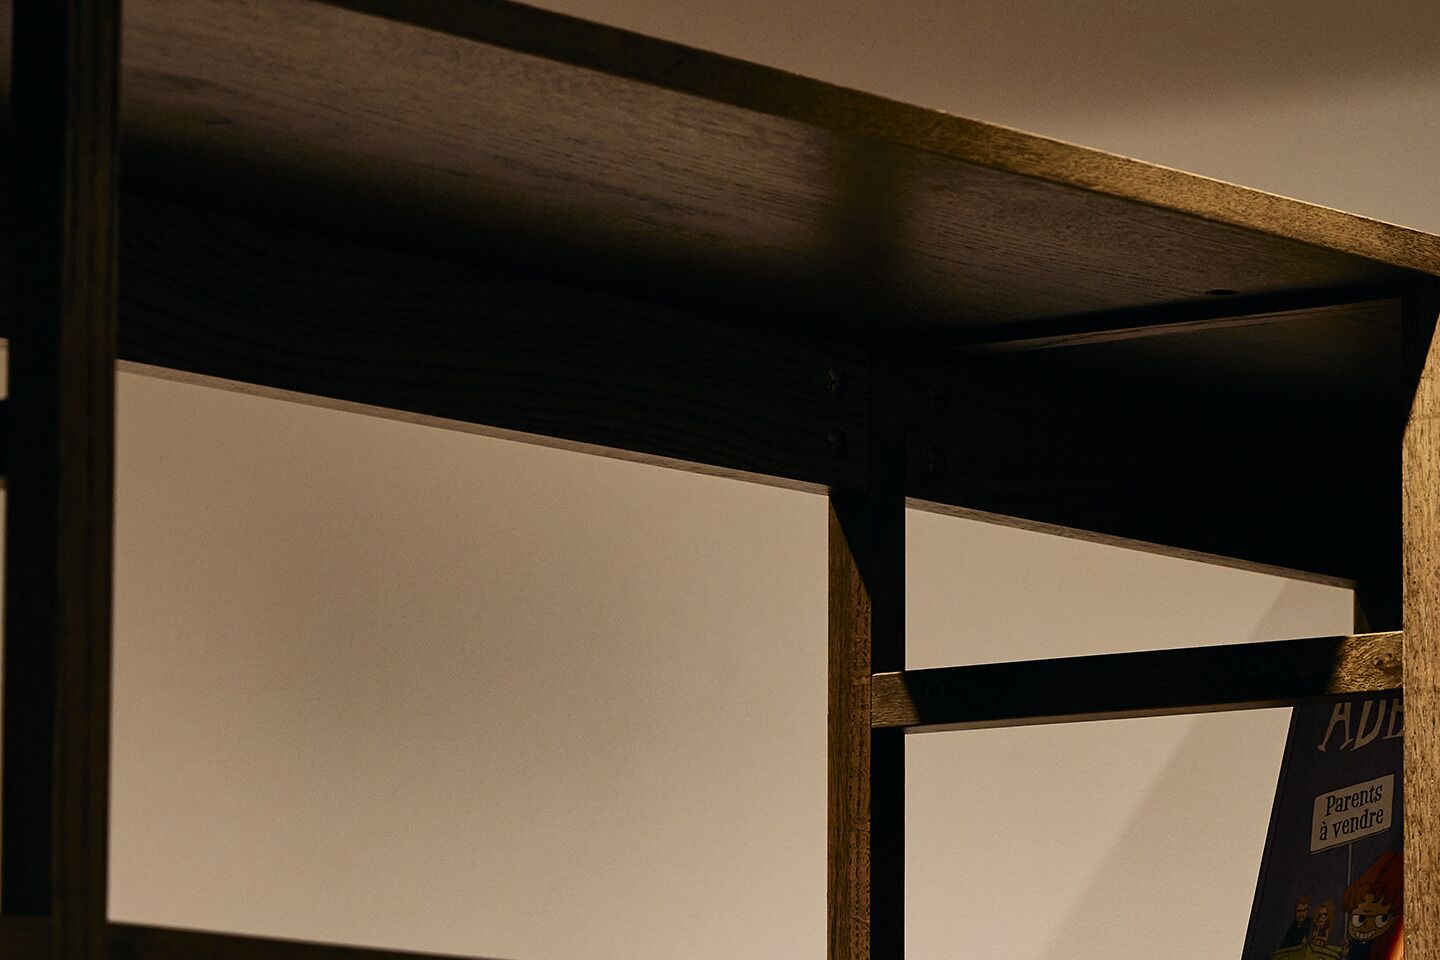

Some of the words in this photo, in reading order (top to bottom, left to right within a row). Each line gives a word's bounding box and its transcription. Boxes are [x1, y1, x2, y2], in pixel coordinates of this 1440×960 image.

[1325, 783, 1382, 817] Parents
[1319, 821, 1328, 841] à
[1333, 807, 1384, 839] vendre
